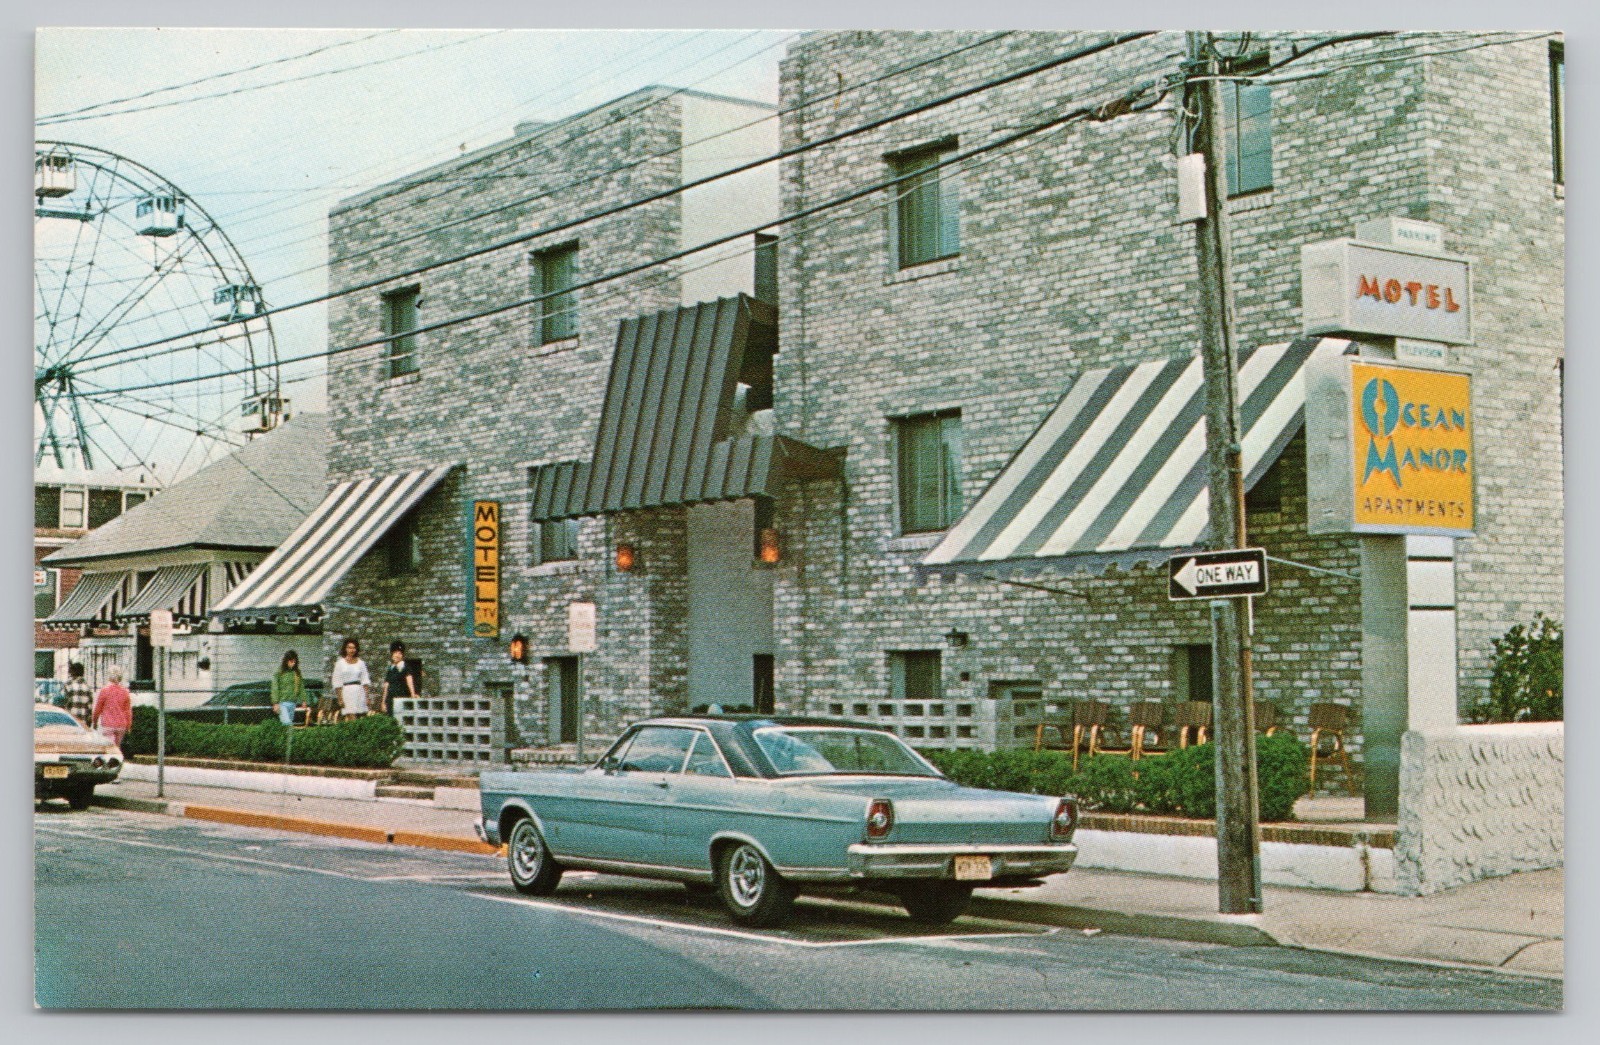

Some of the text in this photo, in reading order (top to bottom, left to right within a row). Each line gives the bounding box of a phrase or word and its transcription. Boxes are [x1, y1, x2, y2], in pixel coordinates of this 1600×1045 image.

[1357, 274, 1461, 313] MOTEL
[1361, 377, 1466, 437] OCEAN
[1362, 437, 1468, 489] MANOR
[1363, 497, 1465, 519] APARTMENTS
[475, 505, 496, 603] MOTEL
[1196, 564, 1253, 584] ONE WAY
